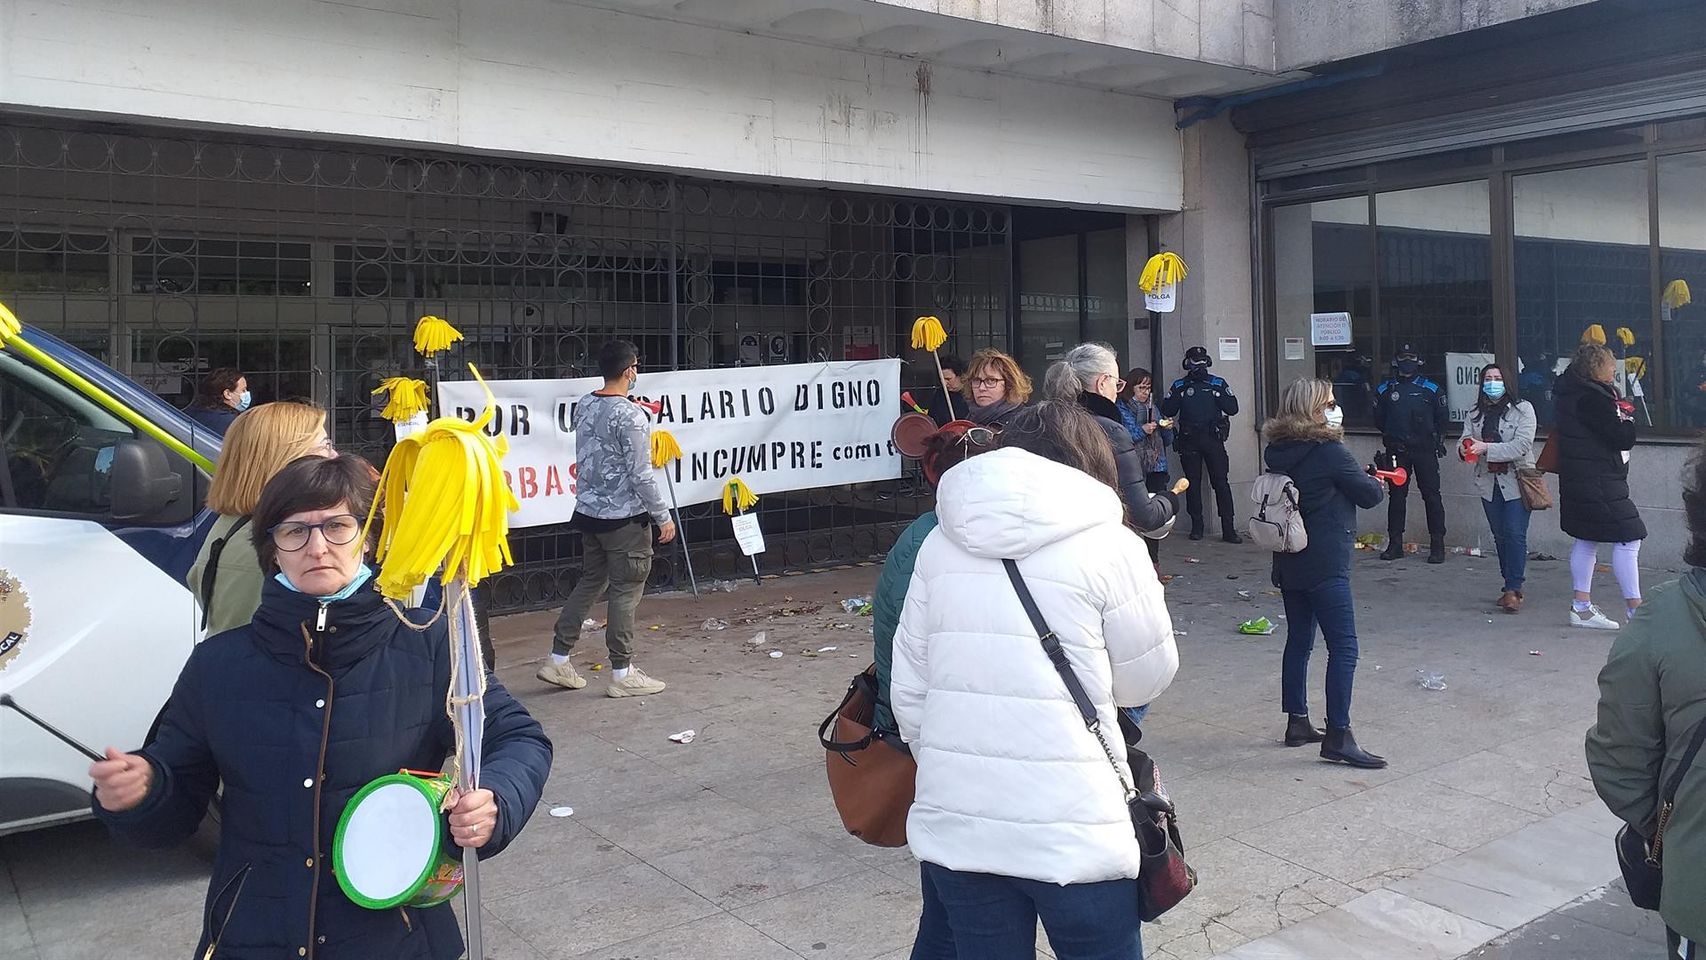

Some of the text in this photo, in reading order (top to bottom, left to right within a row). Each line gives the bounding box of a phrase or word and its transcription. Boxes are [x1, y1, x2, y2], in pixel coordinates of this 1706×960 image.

[558, 403, 577, 433] U
[794, 379, 881, 412] DIGNO
[675, 440, 823, 483] INCUMPRE
[832, 440, 899, 462] comit
[0, 635, 18, 653] CAL
